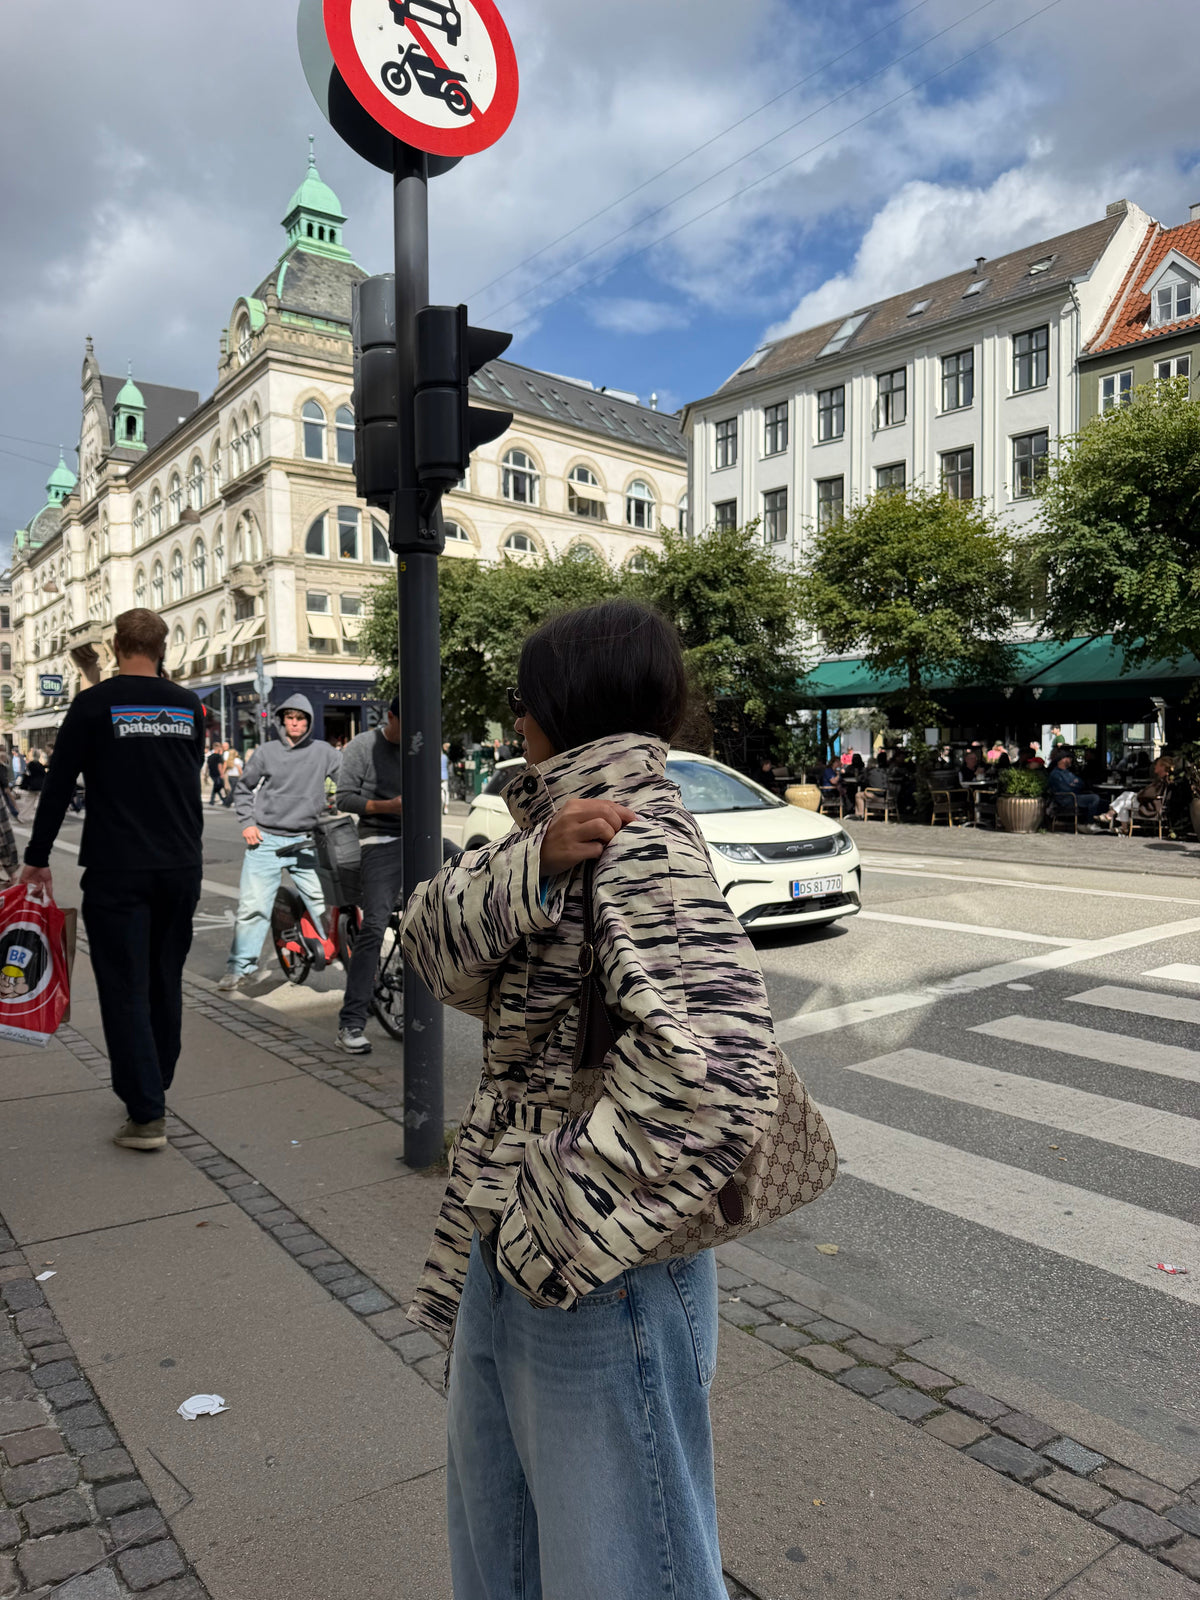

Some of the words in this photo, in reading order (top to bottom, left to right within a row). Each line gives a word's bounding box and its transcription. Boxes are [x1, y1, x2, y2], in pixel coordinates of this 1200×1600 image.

[400, 561, 406, 571] 5
[119, 722, 191, 736] patagonia
[800, 882, 811, 894] DS
[814, 881, 823, 892] 81
[826, 878, 840, 890] 770
[10, 949, 26, 964] BR
